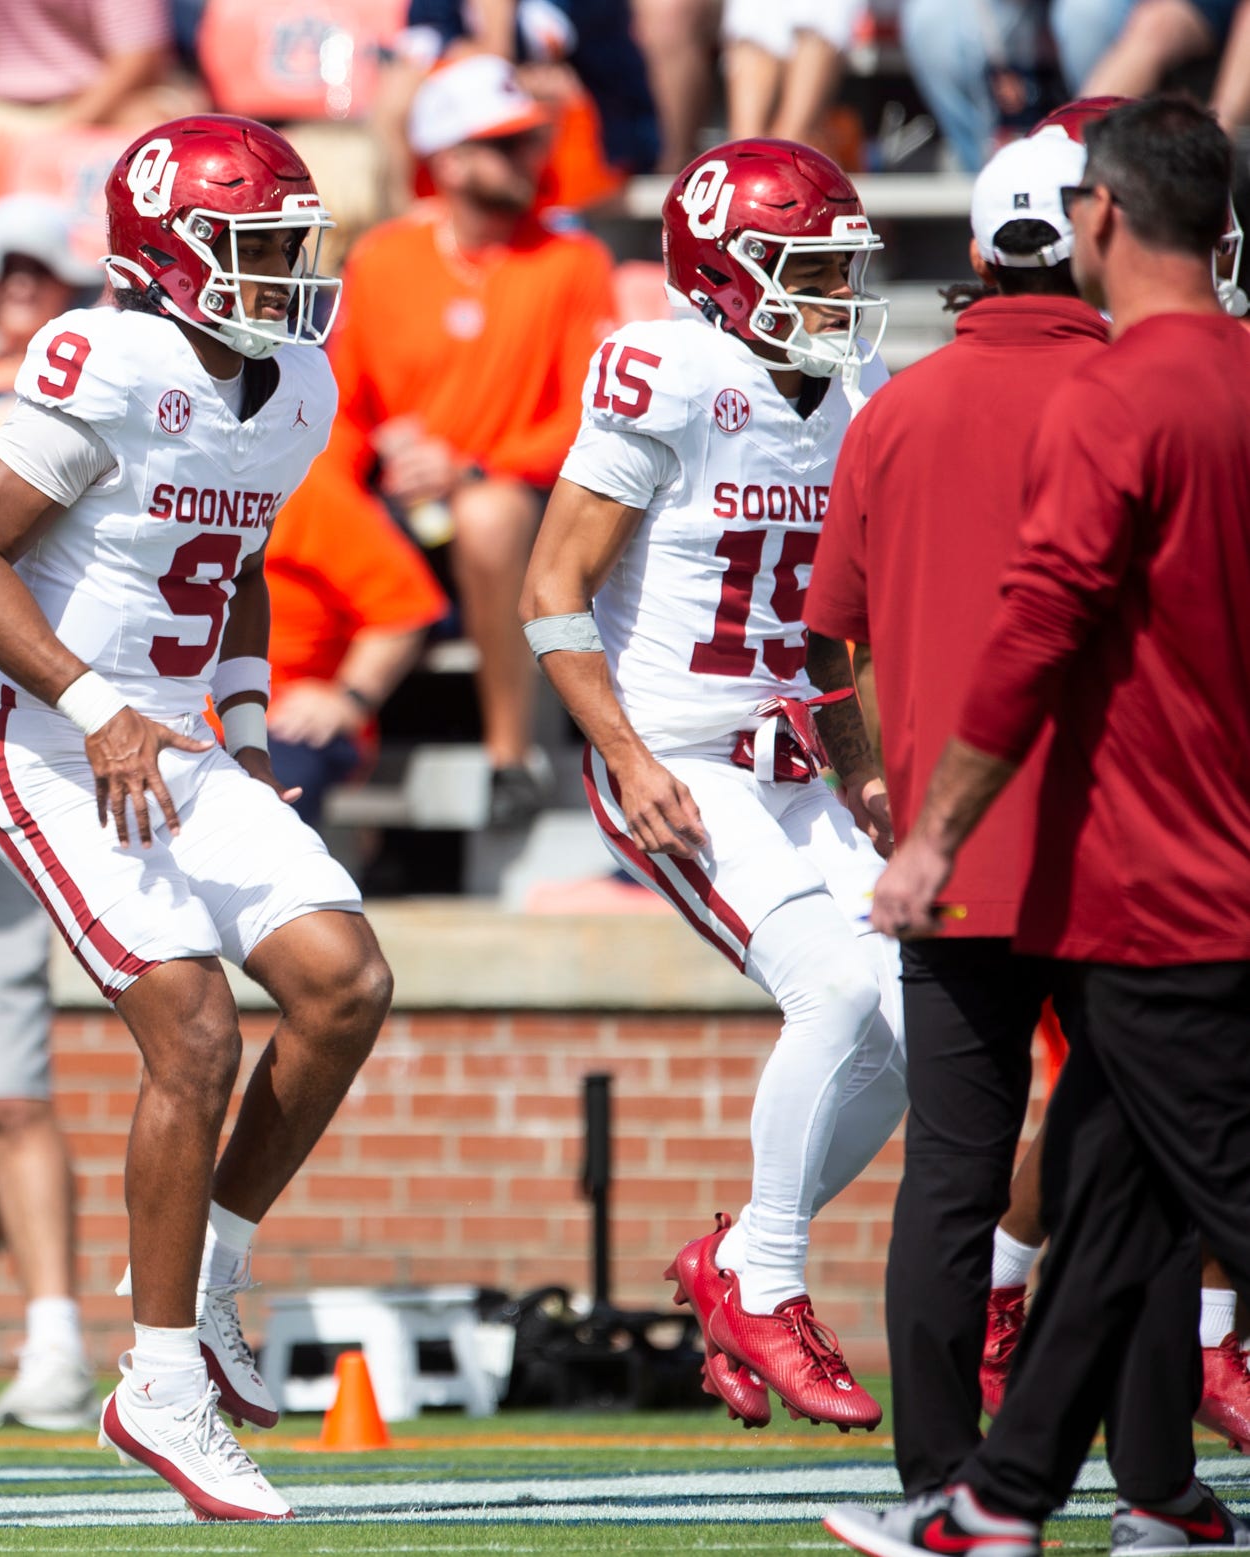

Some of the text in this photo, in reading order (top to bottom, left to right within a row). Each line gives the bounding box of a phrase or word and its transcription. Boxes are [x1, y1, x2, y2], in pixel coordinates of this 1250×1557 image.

[127, 138, 179, 218] OU
[682, 160, 735, 240] OU
[37, 331, 92, 400] 9
[593, 342, 662, 419] 15
[159, 389, 191, 433] SEC
[715, 388, 750, 432] SEC
[713, 482, 831, 522] SOONE
[148, 532, 243, 678] 9
[689, 530, 823, 682] 15
